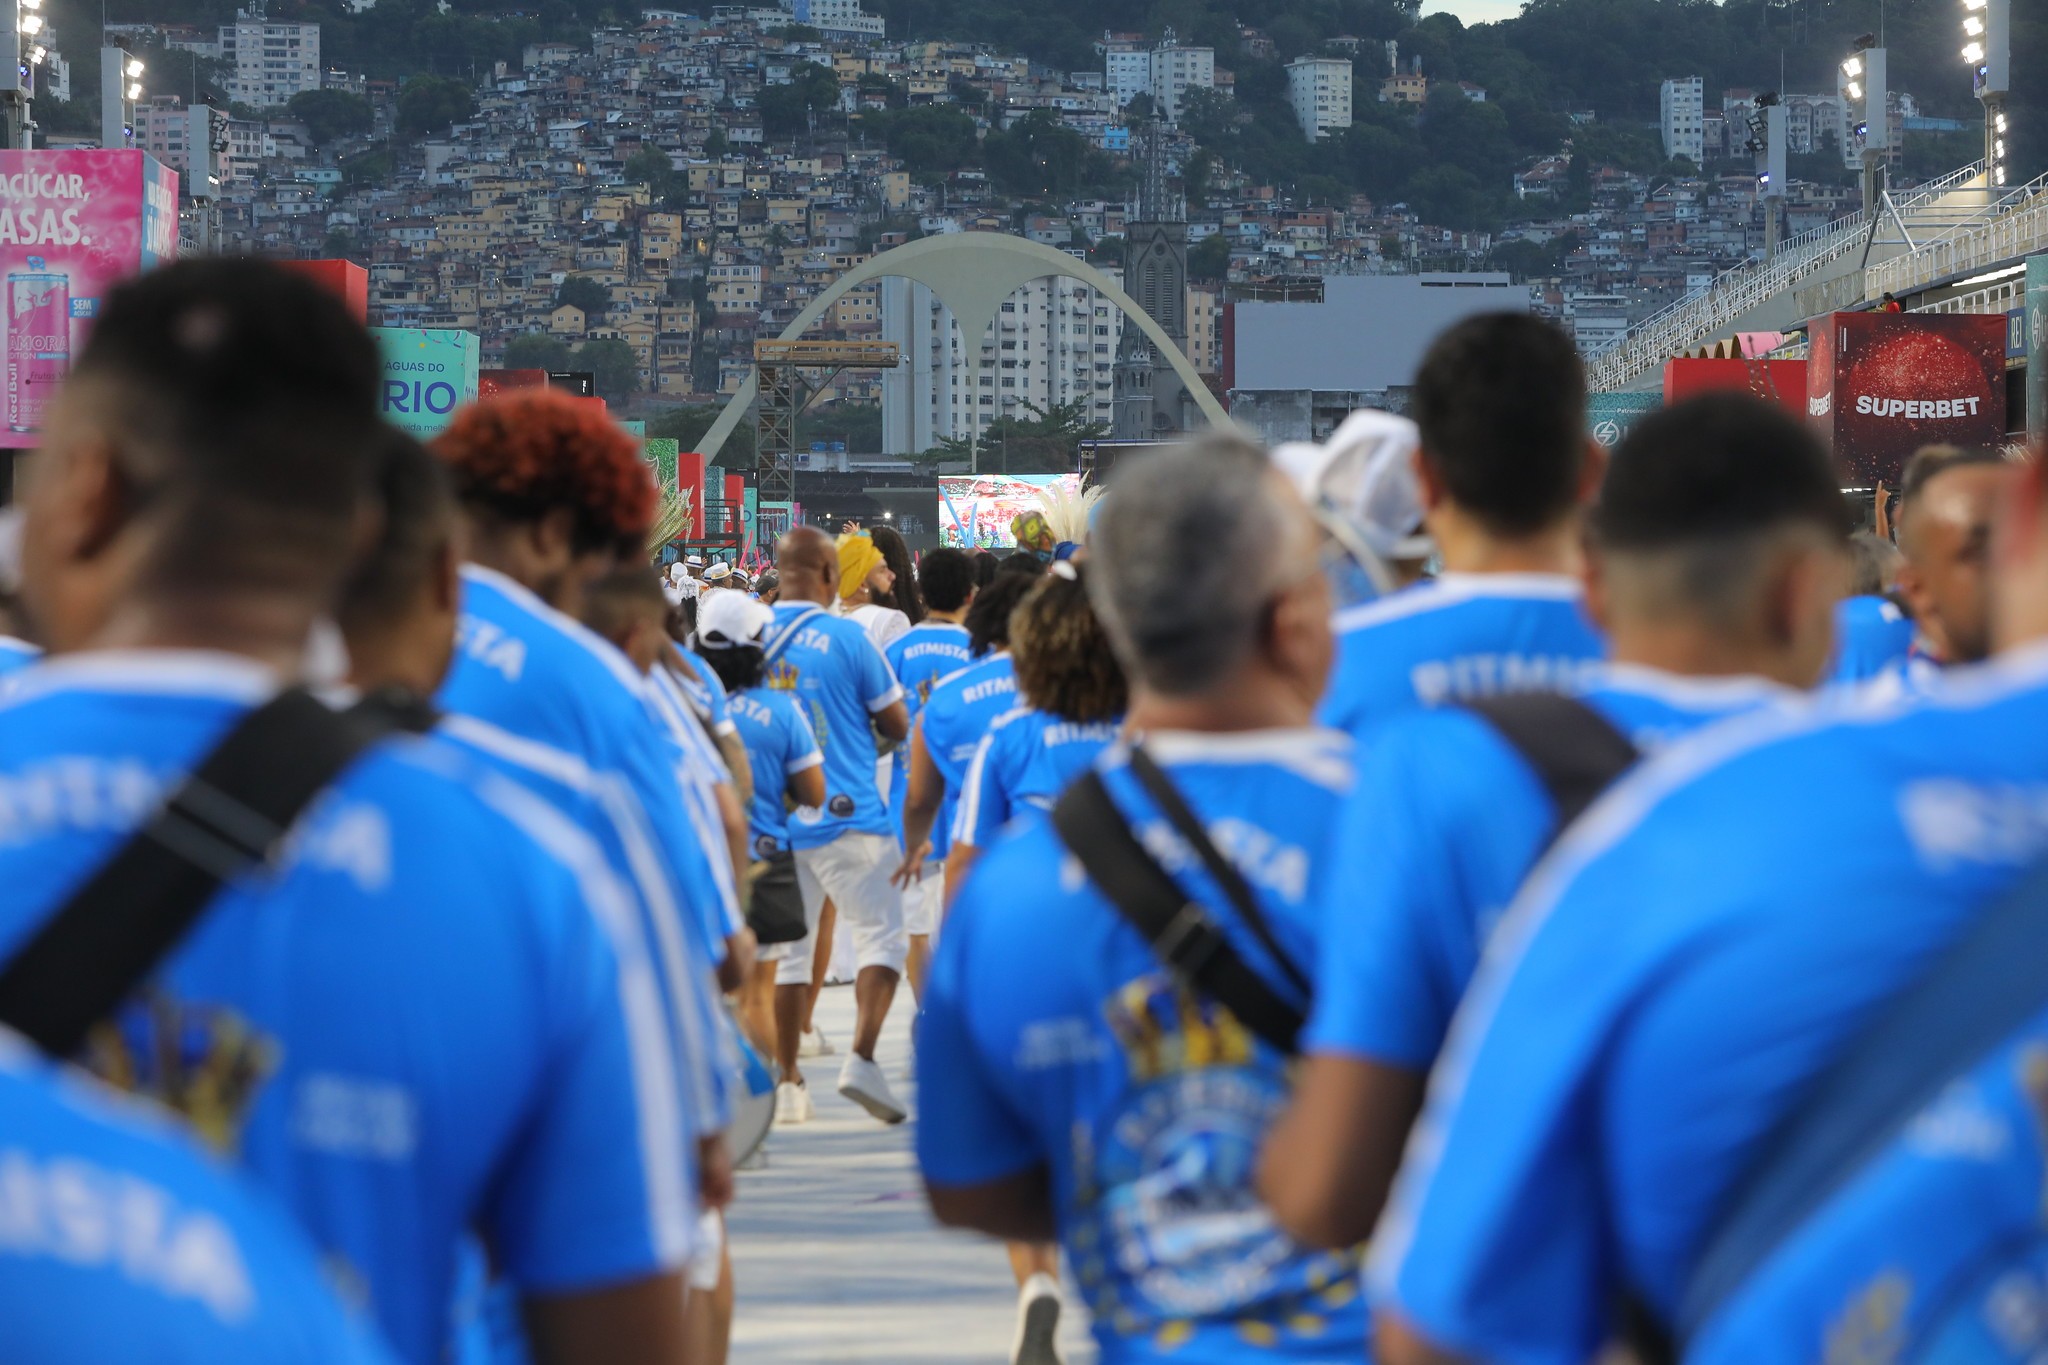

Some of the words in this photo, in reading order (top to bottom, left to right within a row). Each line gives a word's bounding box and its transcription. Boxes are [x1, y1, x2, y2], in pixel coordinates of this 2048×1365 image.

[0, 208, 91, 246] ASAS.
[73, 299, 92, 310] SEM
[8, 335, 69, 352] AMORA
[2011, 316, 2022, 349] REI
[428, 363, 445, 373] DO
[383, 380, 457, 415] RIO
[1809, 391, 1832, 417] SUPERBET
[1856, 395, 1980, 420] SUPERBET
[904, 643, 970, 662] RITMISTA
